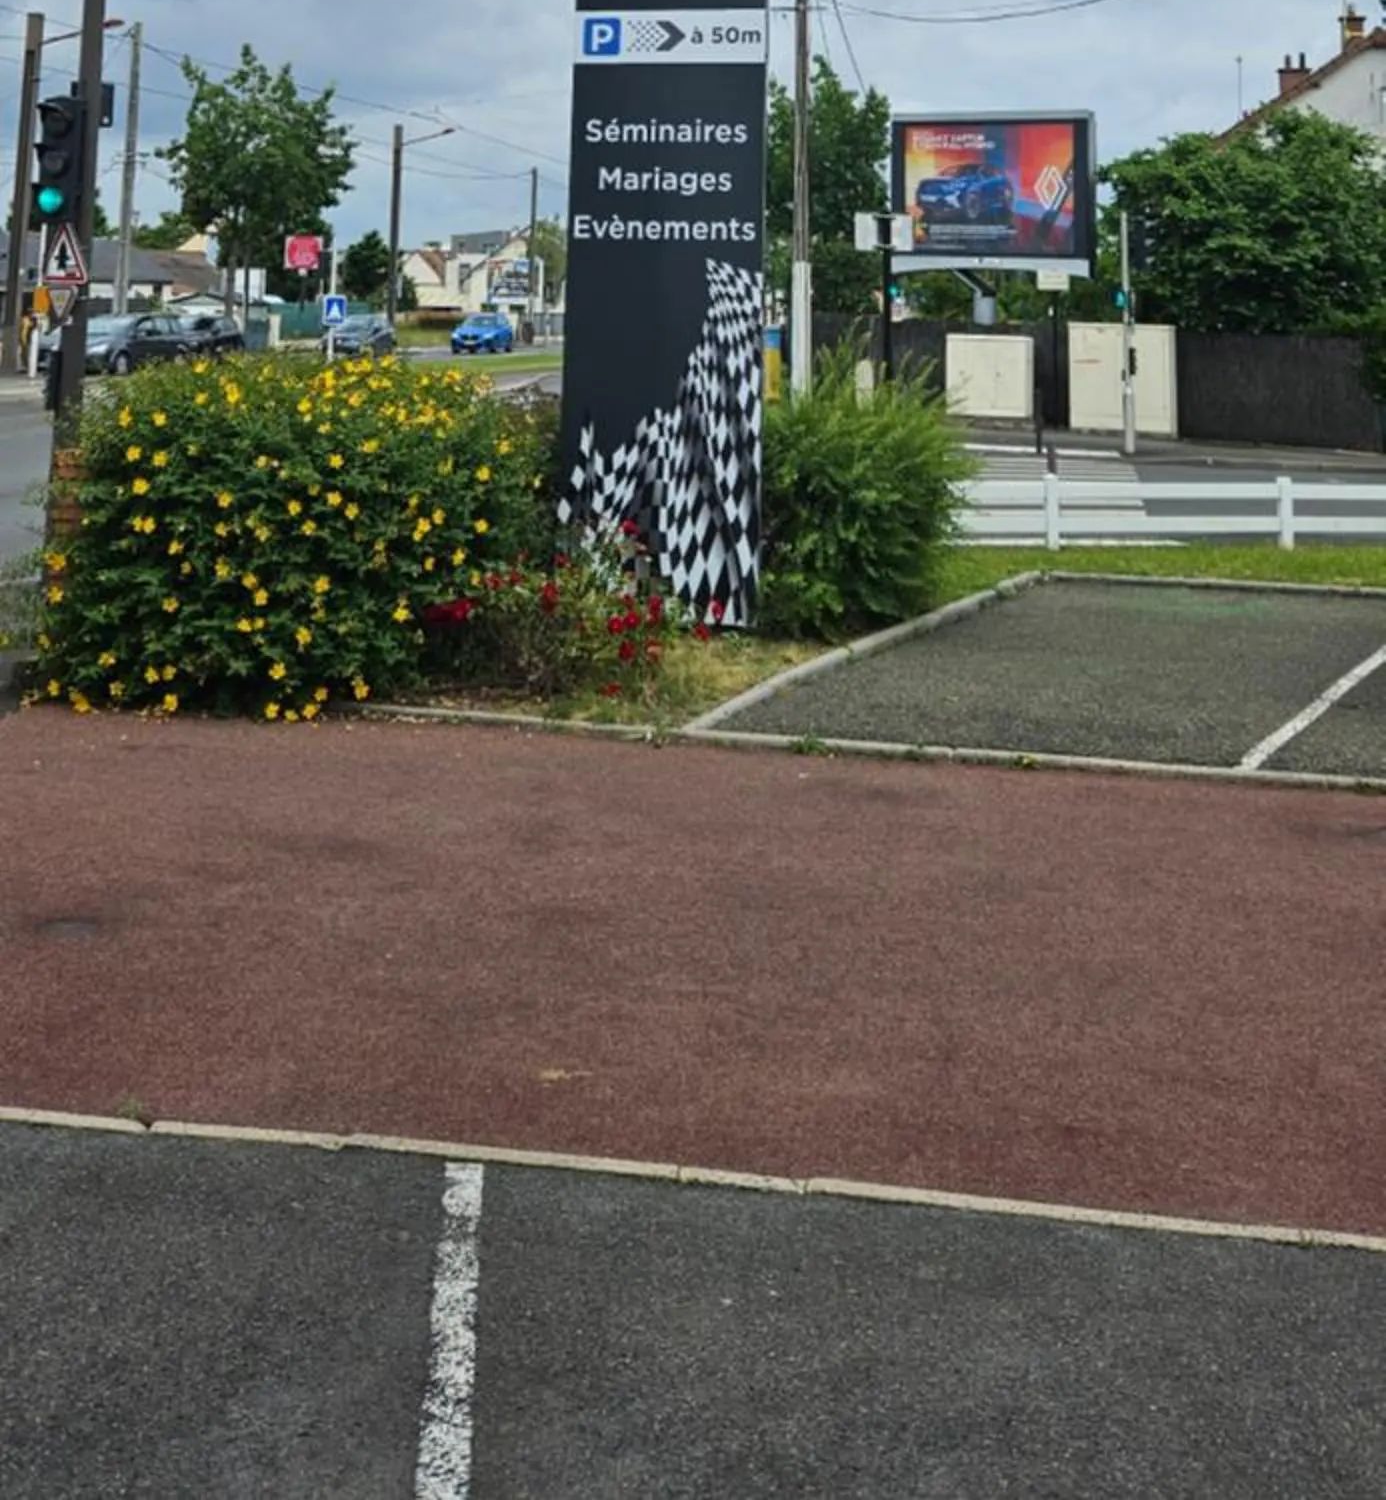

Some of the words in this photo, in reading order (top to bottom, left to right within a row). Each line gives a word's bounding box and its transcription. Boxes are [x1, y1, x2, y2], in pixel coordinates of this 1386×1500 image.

[590, 23, 613, 52] P
[689, 26, 704, 45] à
[711, 26, 762, 45] 50m
[584, 118, 749, 144] Séminaires
[597, 166, 733, 196] Mariages
[572, 213, 757, 242] Evènements
